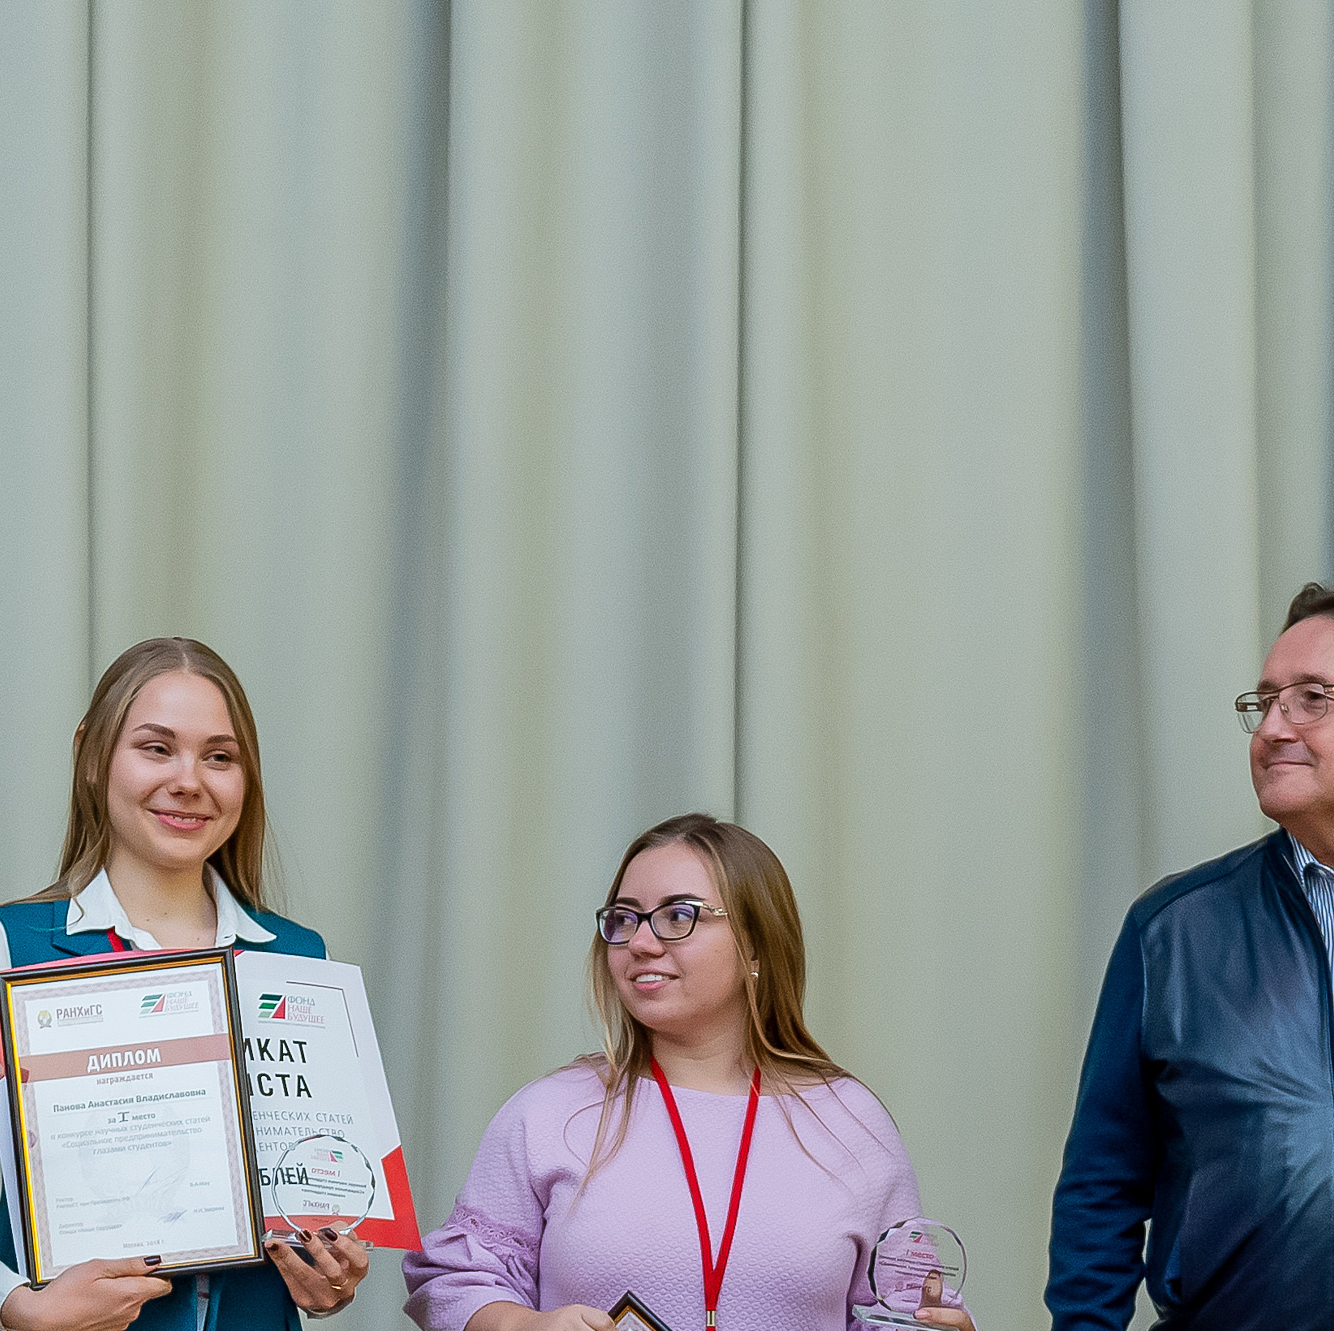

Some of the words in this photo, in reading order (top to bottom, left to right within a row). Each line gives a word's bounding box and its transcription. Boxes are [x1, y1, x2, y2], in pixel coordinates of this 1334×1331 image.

[287, 996, 316, 1006] ФОНД
[56, 1004, 103, 1020] РАНХиГС
[287, 1005, 312, 1014] НАШЕ
[287, 1013, 325, 1024] БУДУЩЕЕ
[87, 1048, 162, 1073] ДИПЛОМ
[96, 1073, 153, 1085] награждается
[53, 1102, 86, 1113] Панова
[87, 1097, 134, 1109] Анастасия
[136, 1089, 207, 1103] Владиславовна
[131, 1112, 156, 1121] место
[315, 1112, 354, 1125] СТАТЕЙ
[57, 1130, 93, 1141] конкурсе
[94, 1125, 128, 1136] научных
[129, 1119, 184, 1134] студенческих
[185, 1115, 211, 1125] статей
[92, 1145, 127, 1155] глазами
